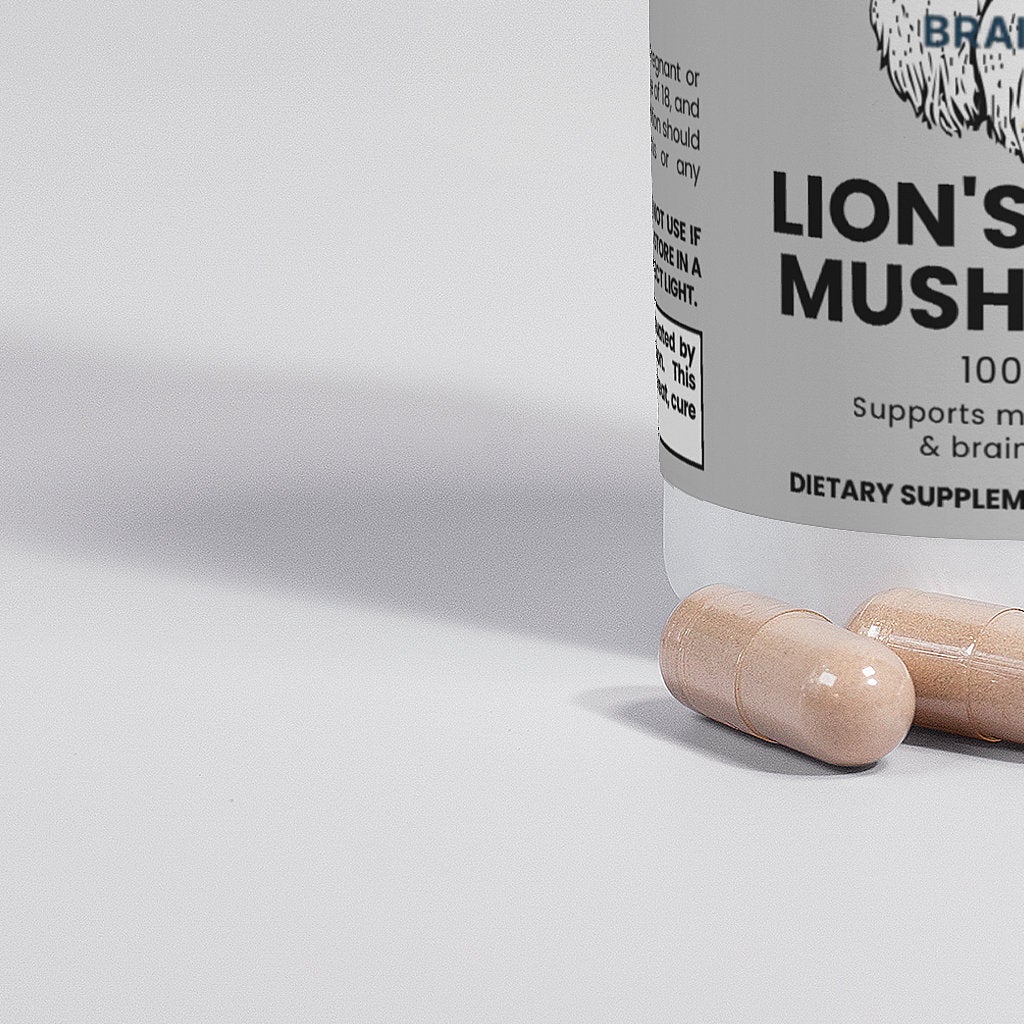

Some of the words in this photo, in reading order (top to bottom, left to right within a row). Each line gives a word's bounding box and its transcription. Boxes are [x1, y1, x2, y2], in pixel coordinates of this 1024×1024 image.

[686, 70, 700, 87] or
[661, 84, 672, 112] 18,
[675, 97, 699, 118] and
[663, 118, 700, 150] should
[661, 150, 669, 168] or
[677, 158, 700, 187] any
[667, 214, 686, 242] USE
[690, 224, 701, 246] IF
[676, 249, 688, 273] IN
[691, 257, 702, 278] A
[664, 272, 698, 307] LIGHT.
[680, 336, 695, 367] by
[672, 360, 696, 390] This
[671, 393, 696, 420] cure
[853, 397, 985, 430] Supports
[919, 435, 940, 457] &
[789, 472, 893, 504] DIETARY
